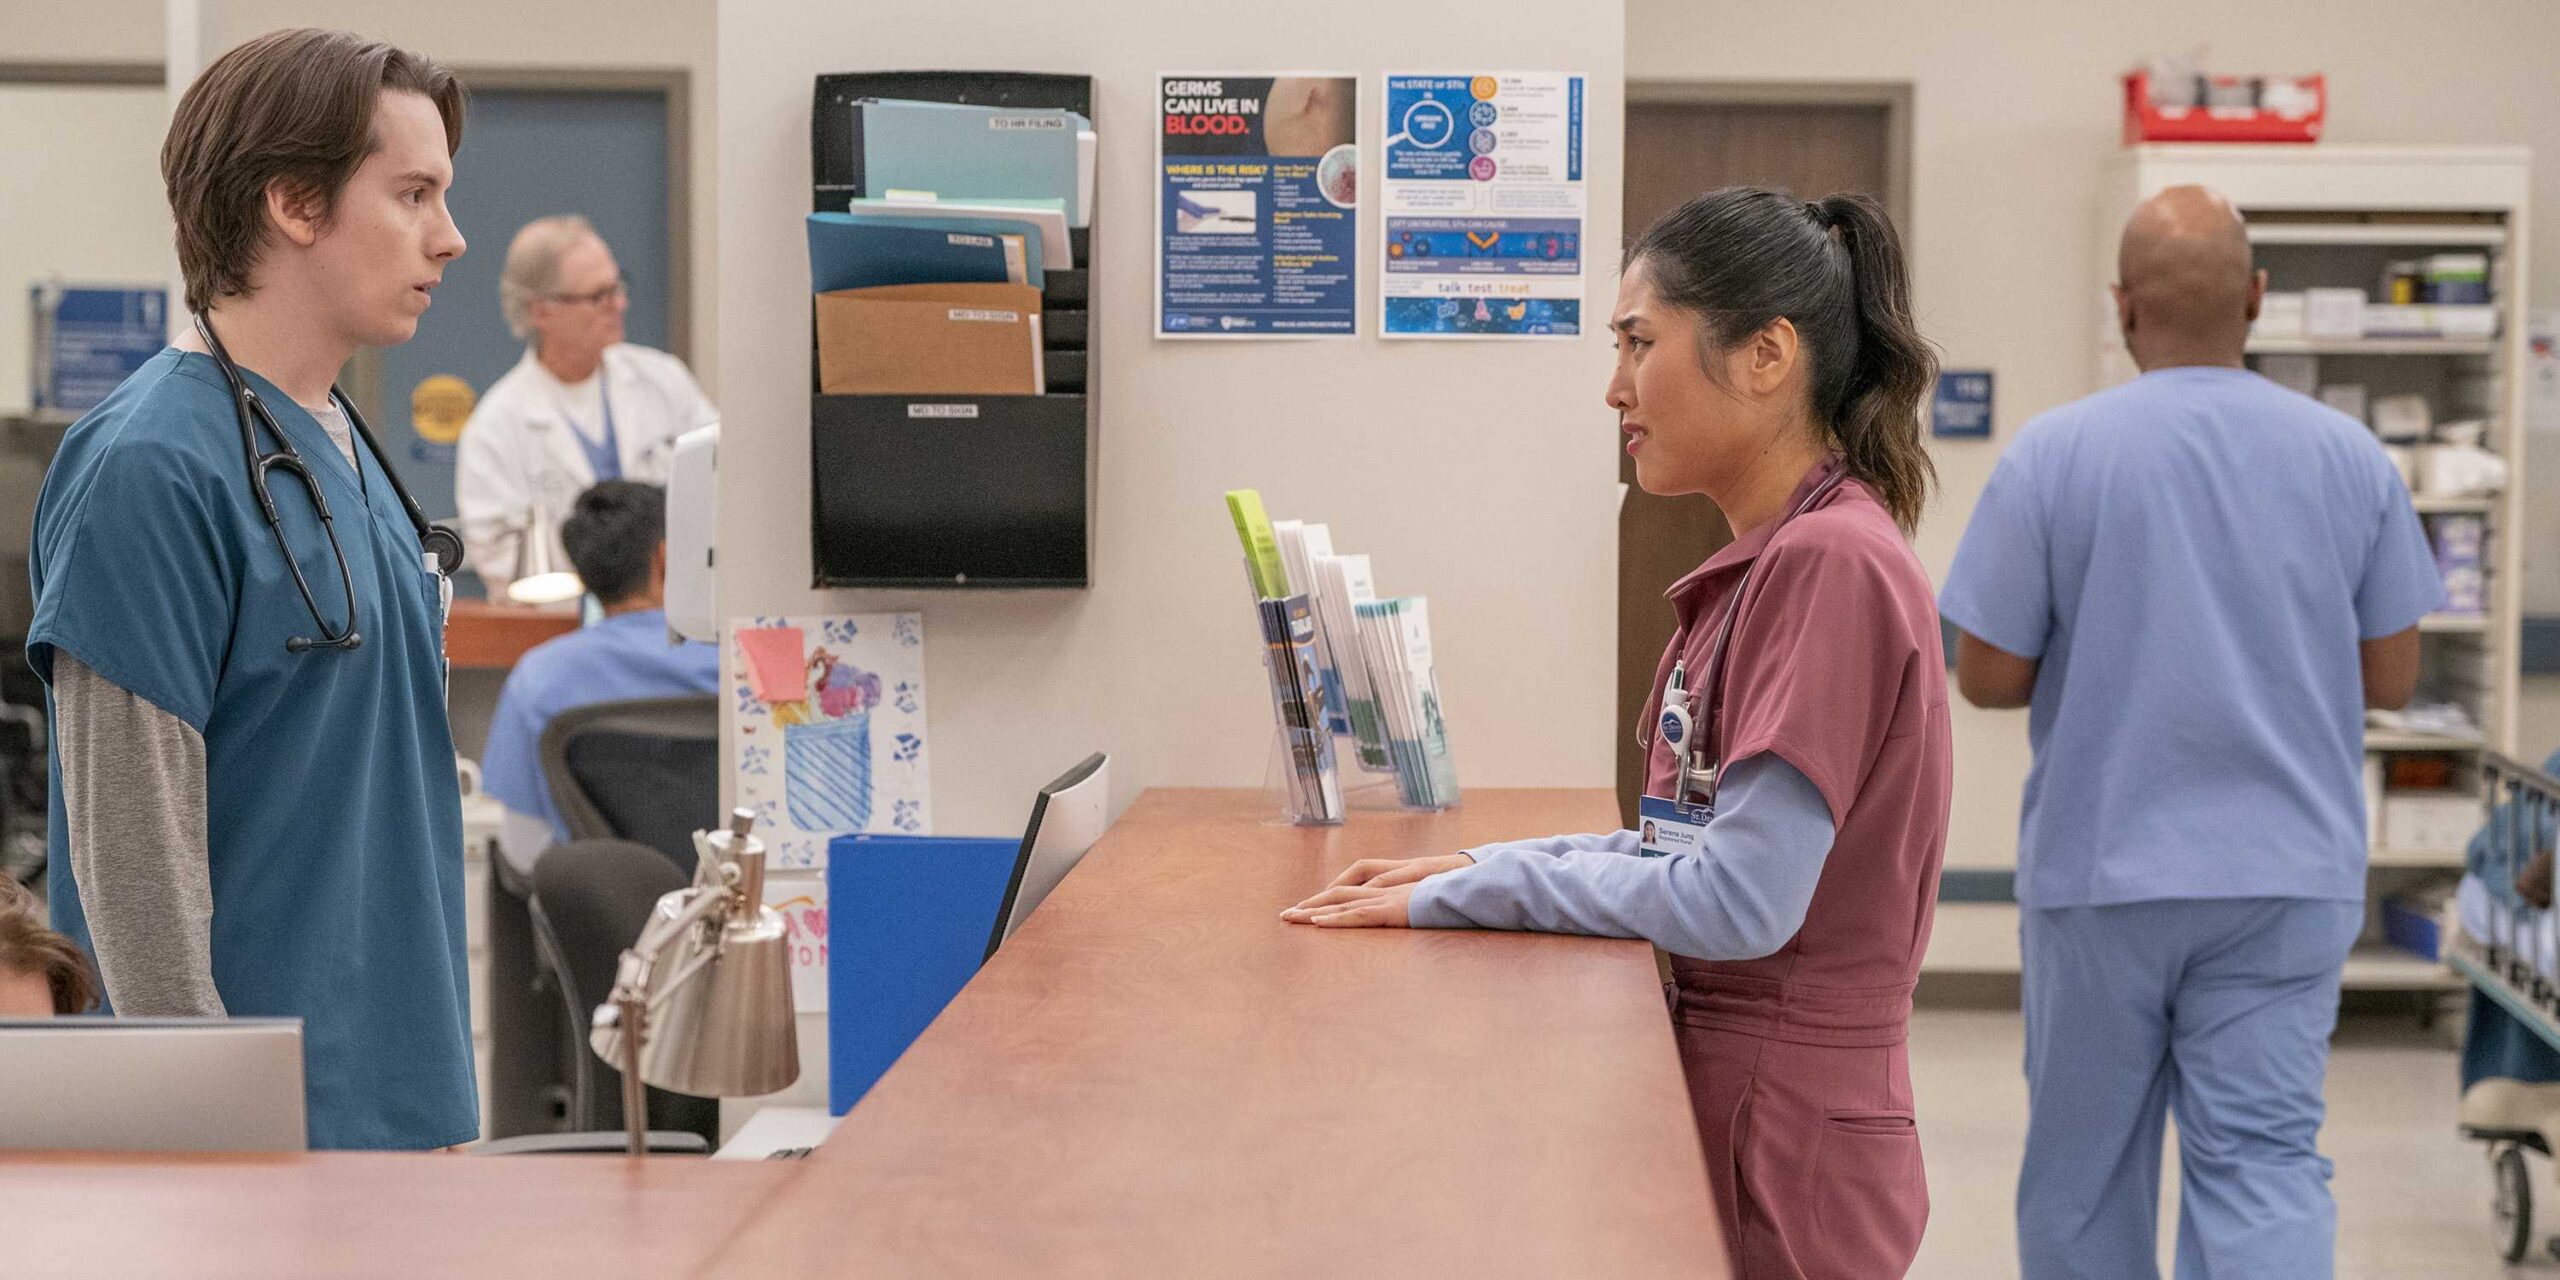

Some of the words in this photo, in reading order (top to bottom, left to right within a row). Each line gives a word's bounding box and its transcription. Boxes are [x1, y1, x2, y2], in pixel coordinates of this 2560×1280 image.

[1164, 80, 1223, 97] GERMS
[1164, 98, 1203, 114] CAN
[1203, 98, 1239, 114] LIVE
[1240, 98, 1260, 114] IN
[994, 119, 1008, 128] TO
[1010, 119, 1025, 128] HR
[1028, 119, 1062, 128] FILING
[1165, 114, 1250, 135] BLOOD.
[1166, 164, 1204, 175] WHERE
[1205, 164, 1216, 175] IS
[1217, 164, 1238, 175] THE
[1238, 164, 1268, 175] RISK?
[1438, 281, 1461, 293] talk
[1468, 282, 1492, 294] test
[1499, 283, 1530, 294] treat
[1658, 827, 1680, 837] Serena
[1680, 832, 1694, 841] Jung
